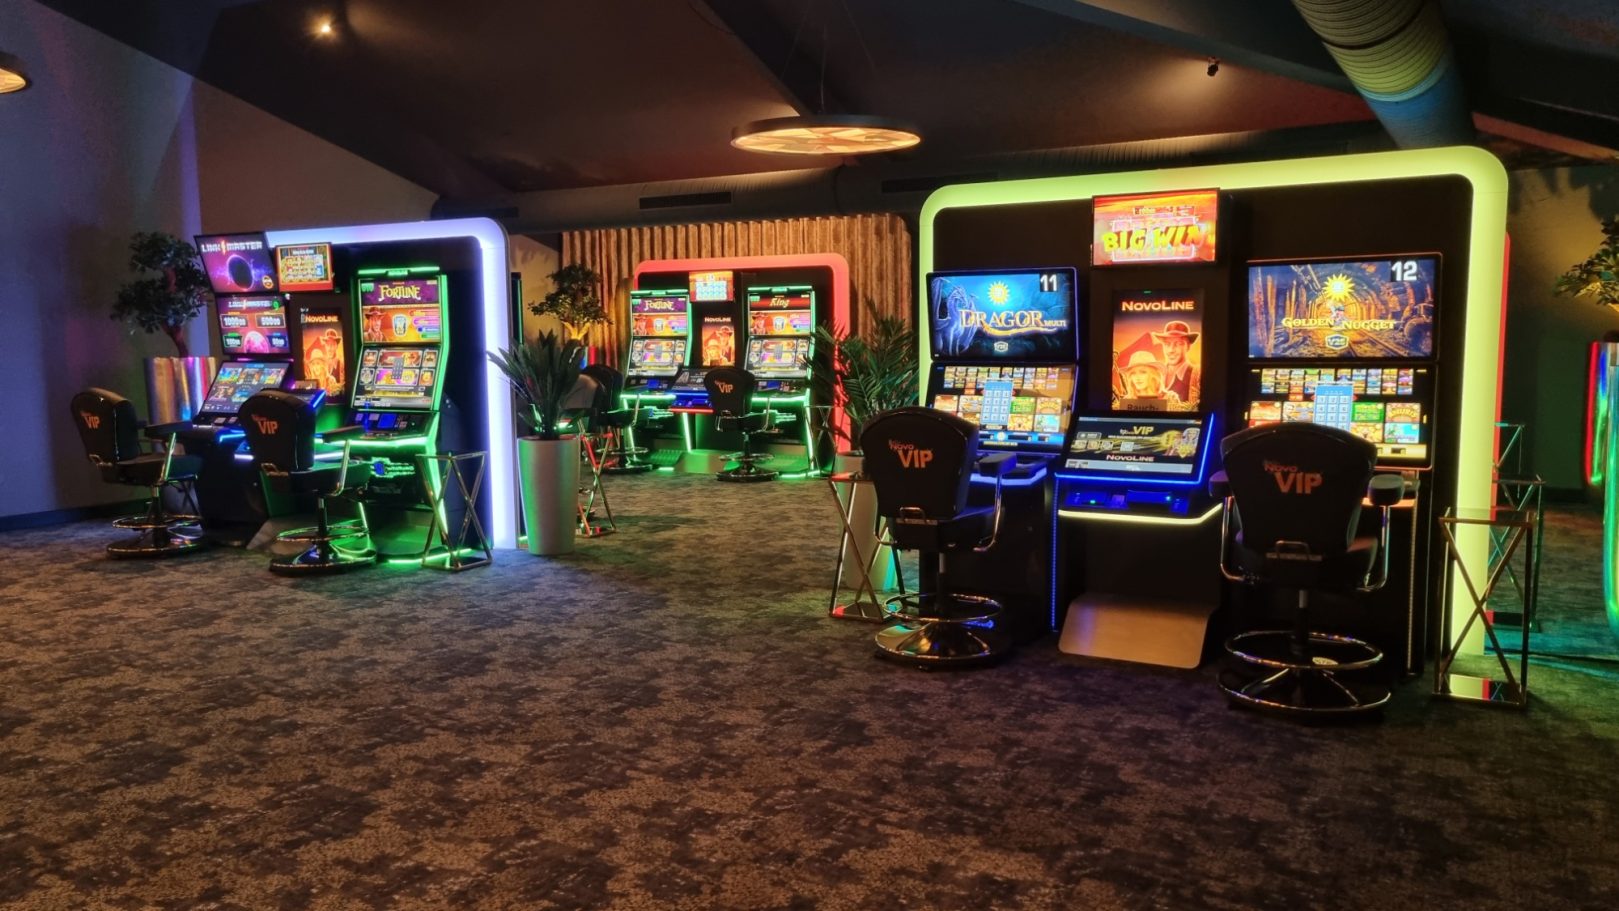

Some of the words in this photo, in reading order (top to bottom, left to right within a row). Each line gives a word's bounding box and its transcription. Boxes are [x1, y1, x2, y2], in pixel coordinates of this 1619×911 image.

[226, 241, 263, 251] MASTER
[1103, 228, 1147, 252] BIG
[1152, 225, 1203, 247] WIN
[1391, 261, 1418, 281] 12
[1040, 274, 1058, 291] 11
[959, 308, 1044, 328] DRAGOR
[1281, 317, 1335, 328] GOLDEN
[1341, 319, 1397, 331] NUGGET
[719, 384, 733, 393] VIP
[84, 415, 100, 429] VIP
[258, 421, 278, 434] VIP
[1132, 426, 1155, 435] VIP
[897, 449, 933, 468] VIP
[1274, 472, 1323, 494] VIP
